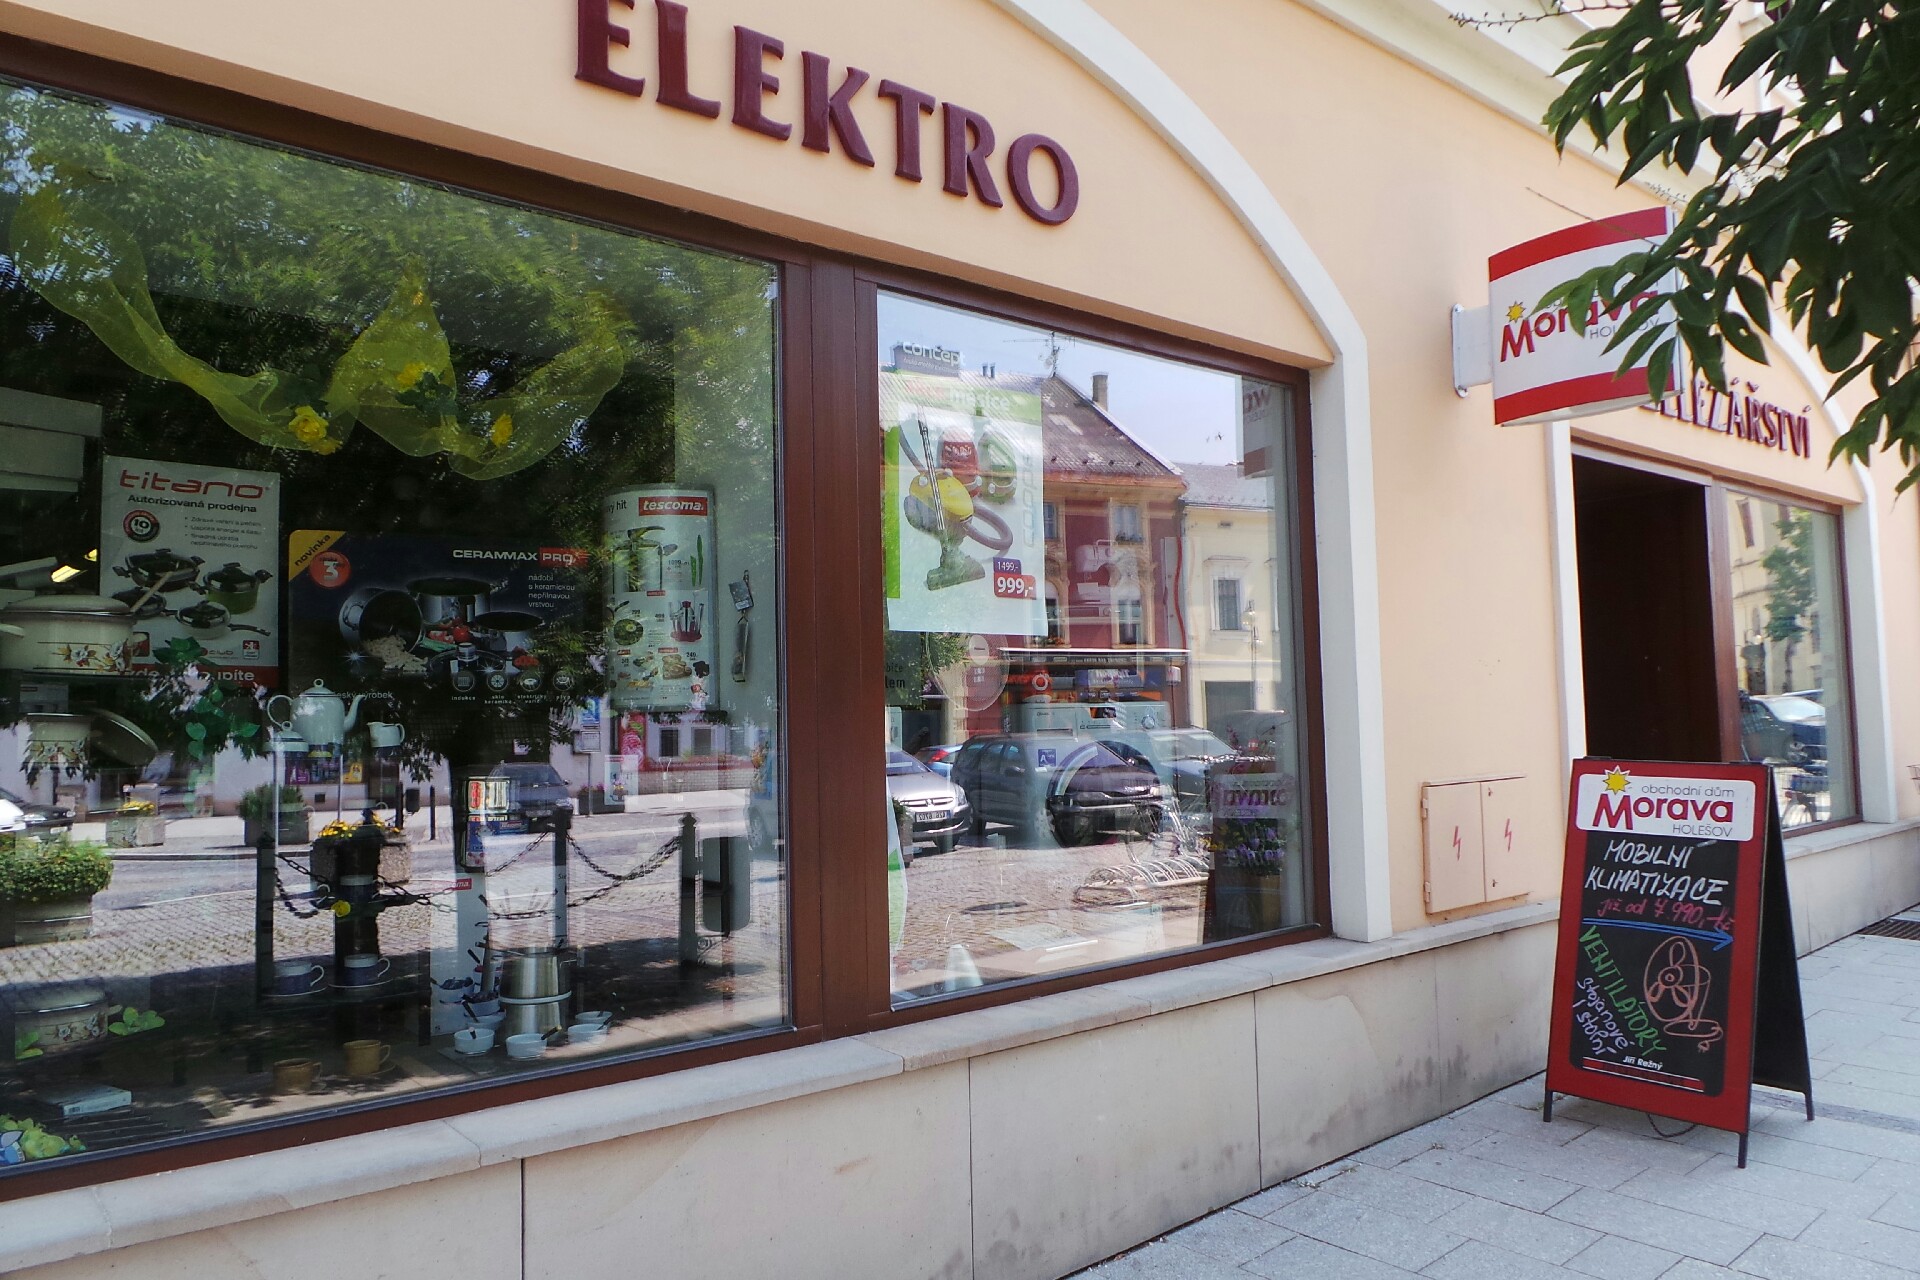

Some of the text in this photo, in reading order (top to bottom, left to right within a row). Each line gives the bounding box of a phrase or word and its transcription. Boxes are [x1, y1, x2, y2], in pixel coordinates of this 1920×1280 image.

[574, 0, 1080, 226] ELEKTRO
[118, 469, 264, 500] titano
[127, 494, 257, 513] Autorizovaná prodejna
[293, 533, 331, 568] novinka
[323, 560, 339, 580] 3
[996, 576, 1034, 597] 999,-
[1641, 783, 1735, 798] obchodní dům
[1592, 793, 1734, 831] Morava
[1672, 823, 1733, 838] HOLEŠOV
[1603, 839, 1718, 869] MOBILNÍ
[1584, 865, 1729, 906] KLIMATIZACE
[1625, 899, 1648, 915] od
[1579, 925, 1667, 1057] VENTILÁTORY
